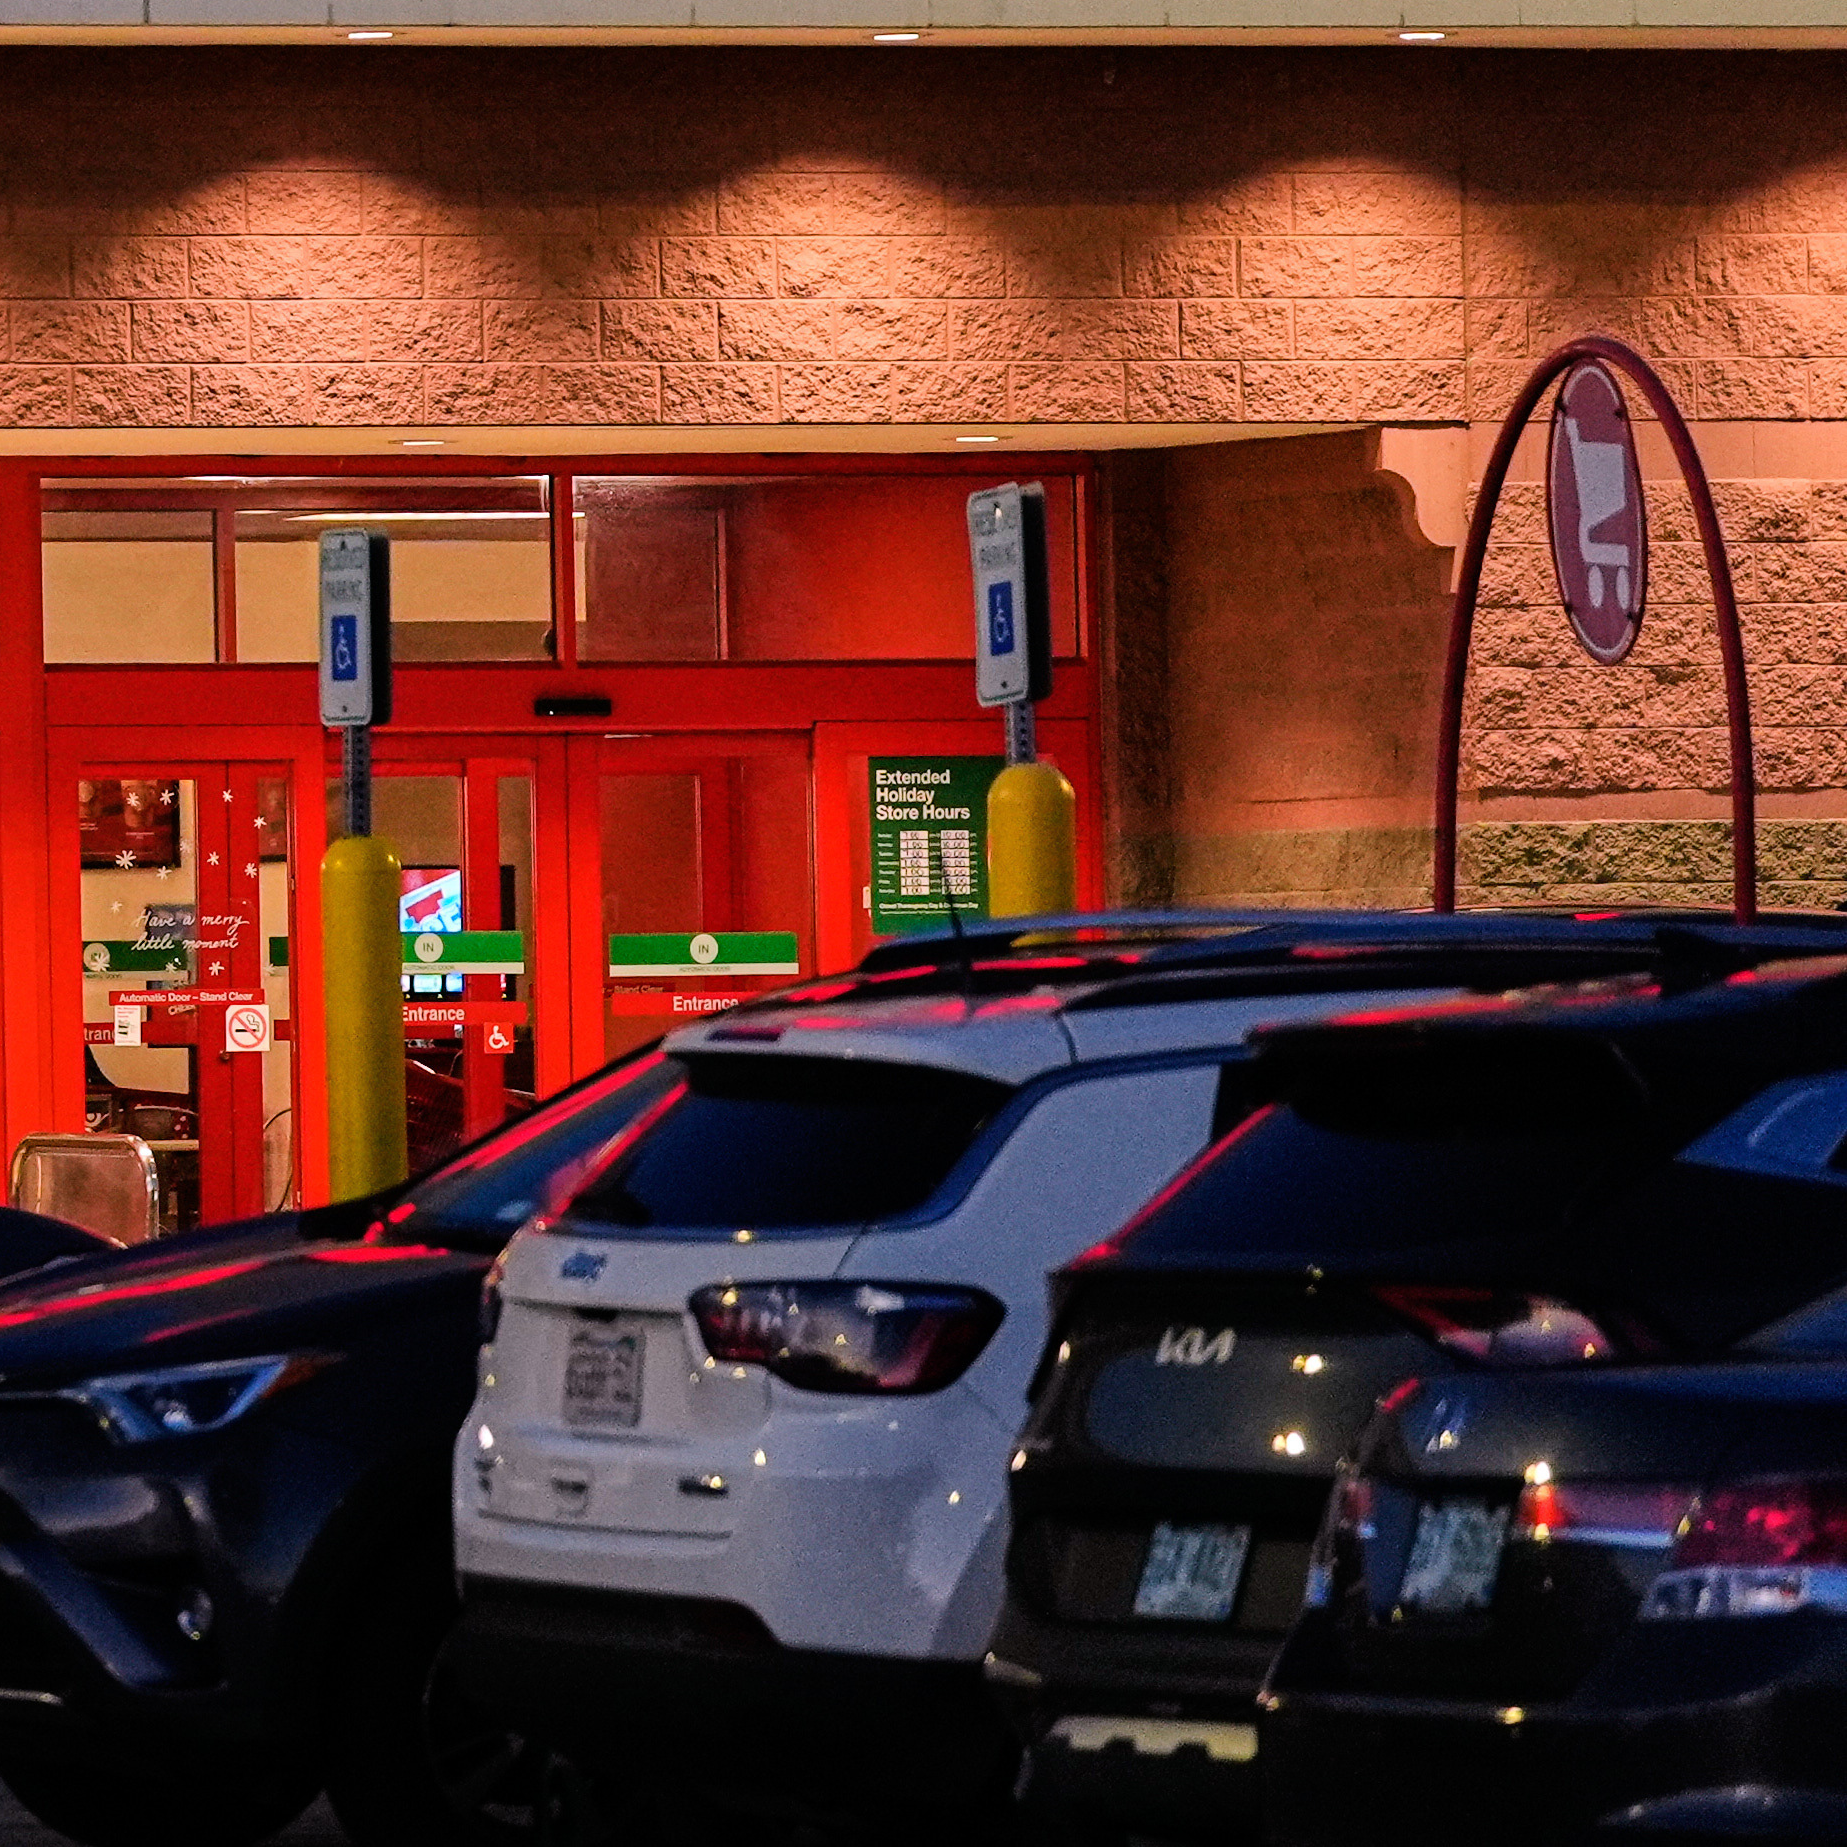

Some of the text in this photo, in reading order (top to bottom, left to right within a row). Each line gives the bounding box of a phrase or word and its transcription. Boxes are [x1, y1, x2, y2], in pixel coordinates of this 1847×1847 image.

[875, 769, 951, 785] Extended
[876, 787, 935, 805] Holiday
[876, 804, 971, 820] Store Hours
[135, 906, 250, 936] Have a merry
[131, 932, 238, 951] little moment
[422, 942, 435, 952] IN
[698, 944, 710, 954] IN
[119, 993, 166, 1003] Automatic
[168, 992, 191, 1002] Door
[199, 991, 227, 1002] Stand
[228, 991, 253, 1001] Clear
